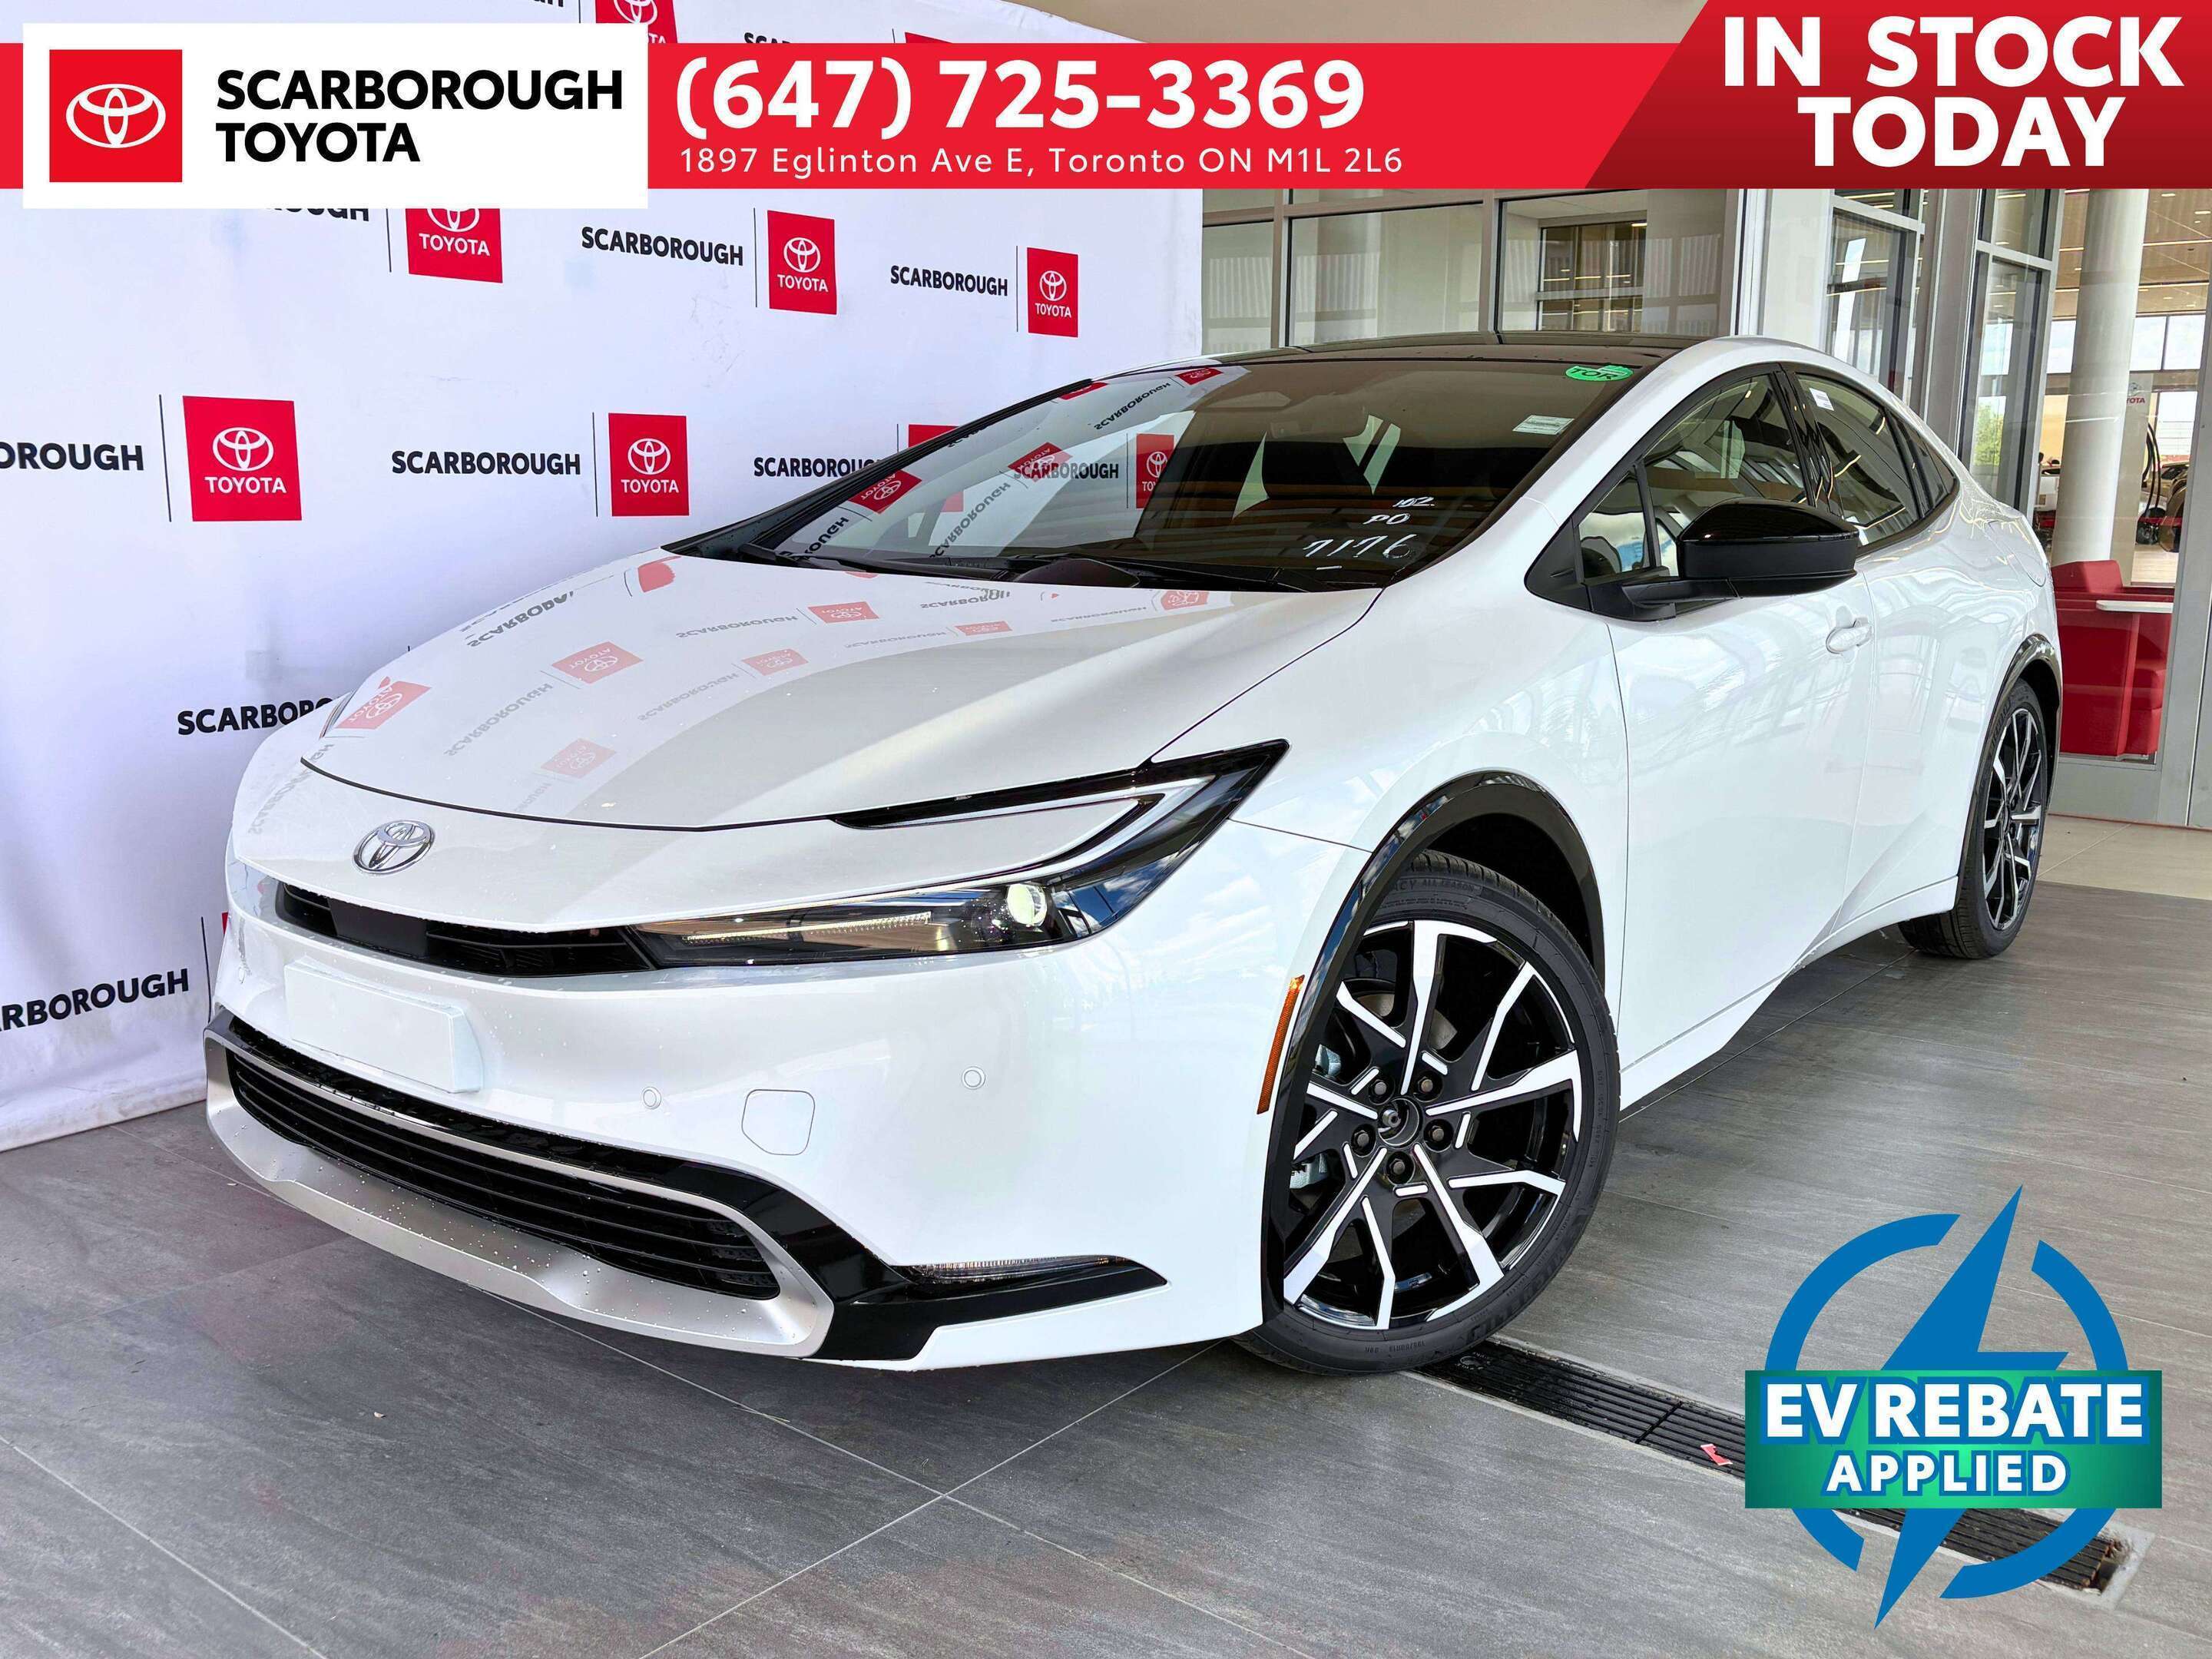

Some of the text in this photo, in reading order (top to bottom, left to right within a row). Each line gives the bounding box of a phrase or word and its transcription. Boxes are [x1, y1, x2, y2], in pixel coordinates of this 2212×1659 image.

[419, 233, 491, 256] TOYOTA
[581, 227, 829, 293] SCARBOROUGH TOYOTA
[890, 265, 1071, 318] SCARBOROUGH TOYOTA
[204, 476, 286, 494] TOYOTA
[392, 451, 679, 494] SCARBOROUGH TOYOTA
[0, 968, 189, 1031] RBOROUGH
